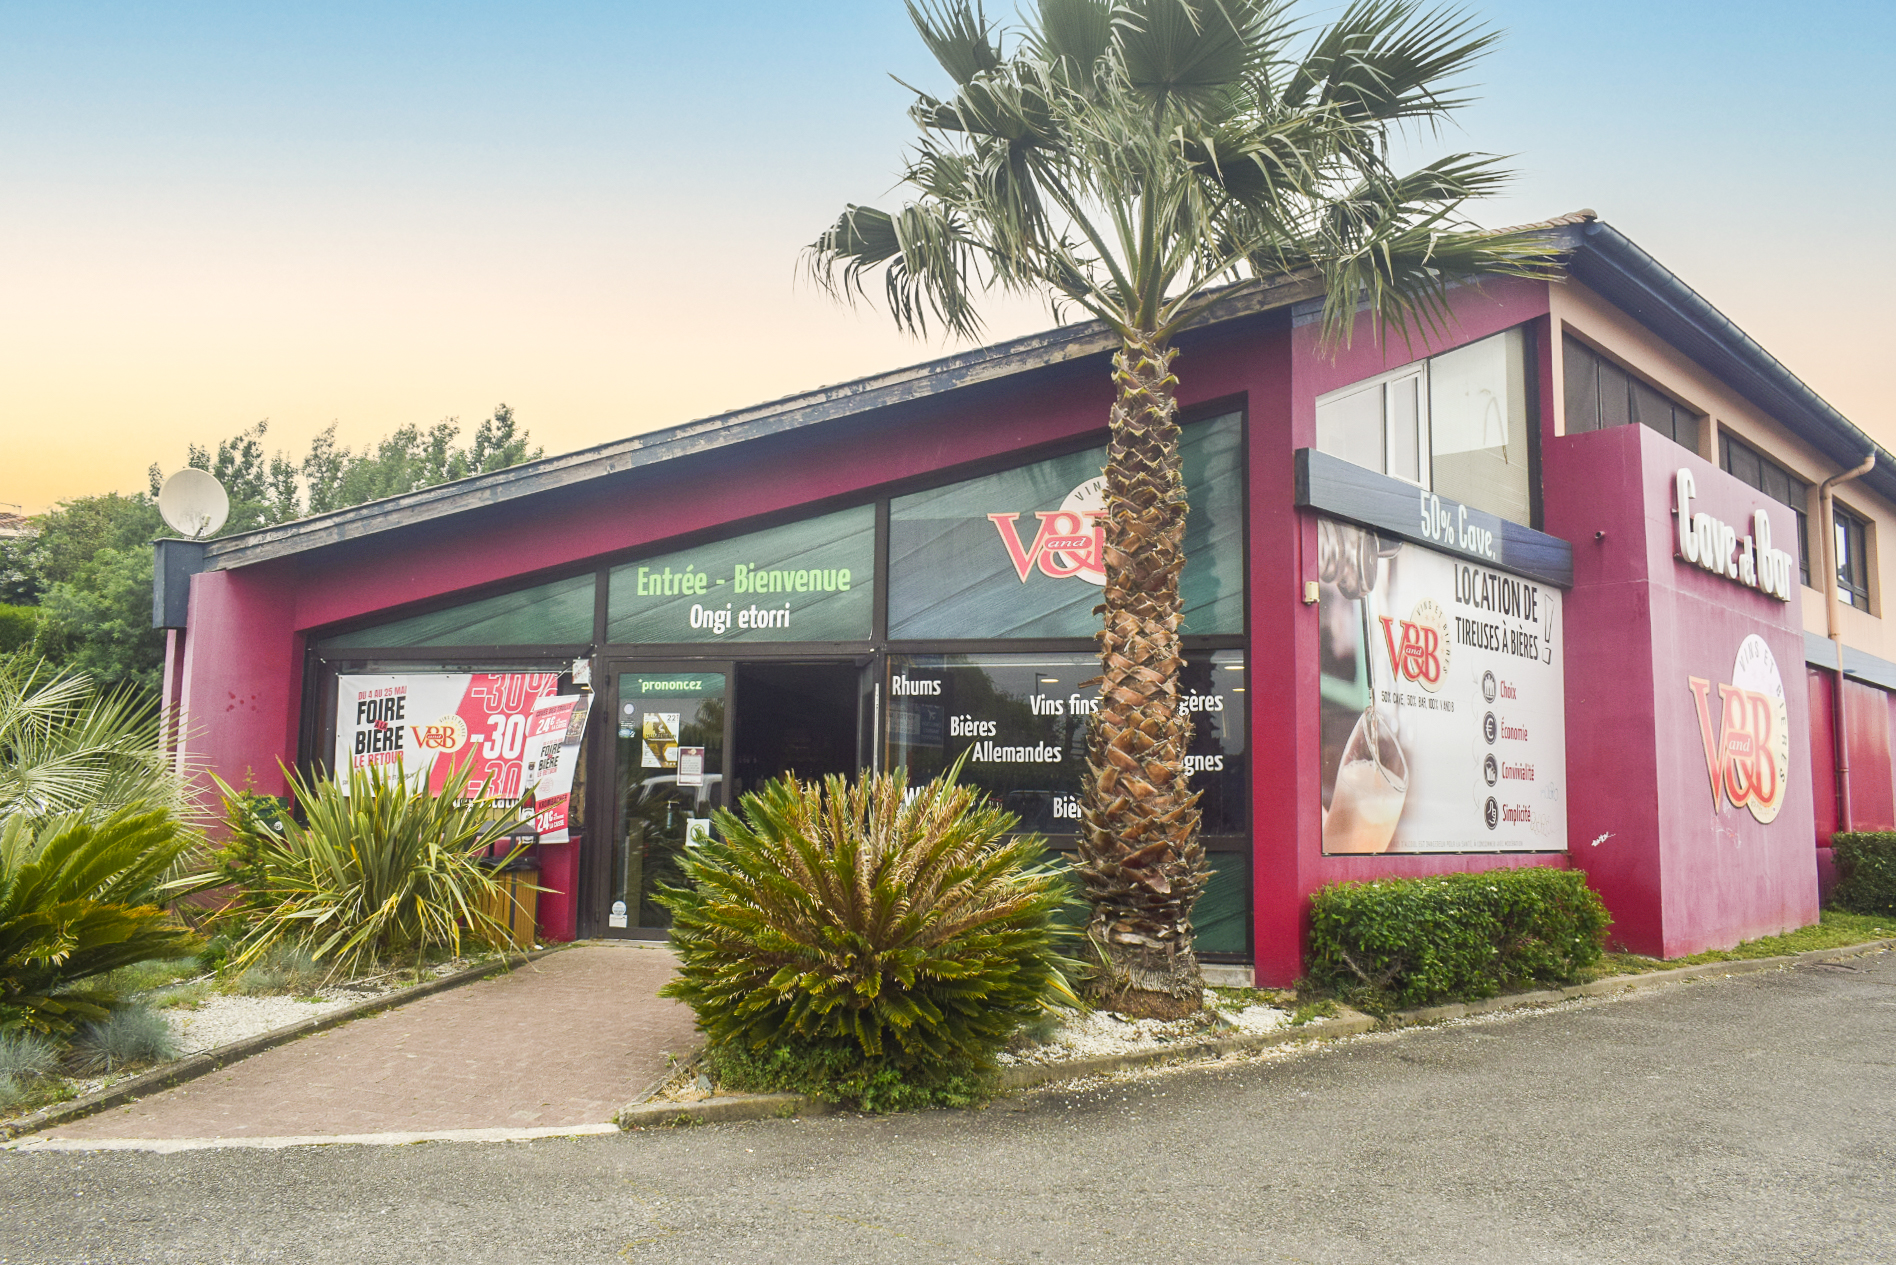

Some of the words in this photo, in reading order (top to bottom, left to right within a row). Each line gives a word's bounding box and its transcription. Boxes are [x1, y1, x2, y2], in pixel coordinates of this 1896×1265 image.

[1074, 481, 1101, 502] VIN
[1420, 490, 1455, 545] 50%
[1458, 504, 1496, 560] Cave.
[1676, 467, 1738, 580] Cave
[1739, 535, 1757, 587] et
[1047, 537, 1086, 548] and
[637, 564, 708, 596] Entrée
[734, 563, 851, 594] Bienvenue
[1454, 564, 1521, 618] LOCATION
[1524, 584, 1538, 623] DE
[690, 603, 732, 635] Ongi
[738, 602, 790, 629] etorri
[1379, 615, 1440, 684] V&B
[1455, 616, 1500, 652] TIREUSES
[1501, 619, 1509, 654] À
[1510, 624, 1538, 661] BIÈRES
[1405, 647, 1422, 656] and
[358, 691, 367, 700] DU
[368, 690, 373, 699] 4
[374, 689, 383, 698] AU
[384, 687, 393, 697] 25
[394, 685, 408, 695] MAI
[892, 675, 942, 696] Rhums
[1500, 680, 1517, 700] Choix
[356, 696, 406, 725] FOIRE
[1030, 694, 1064, 715] Vins
[1069, 694, 1099, 715] fins
[1179, 688, 1224, 717] gères
[410, 725, 456, 749] V&B
[950, 714, 996, 737] Bières
[1501, 717, 1528, 741] Économie
[354, 725, 405, 755] BIERE
[540, 743, 562, 757] FOIRE
[1688, 675, 1777, 815] V&B
[1728, 739, 1751, 753] and
[353, 755, 365, 769] LE
[367, 751, 404, 767] RETOUR
[971, 741, 1063, 763] Allemandes
[1181, 755, 1224, 777] gnes
[1501, 762, 1535, 781] Convivialité
[1053, 795, 1082, 818] Bièr
[1502, 804, 1531, 827] Simplicité
